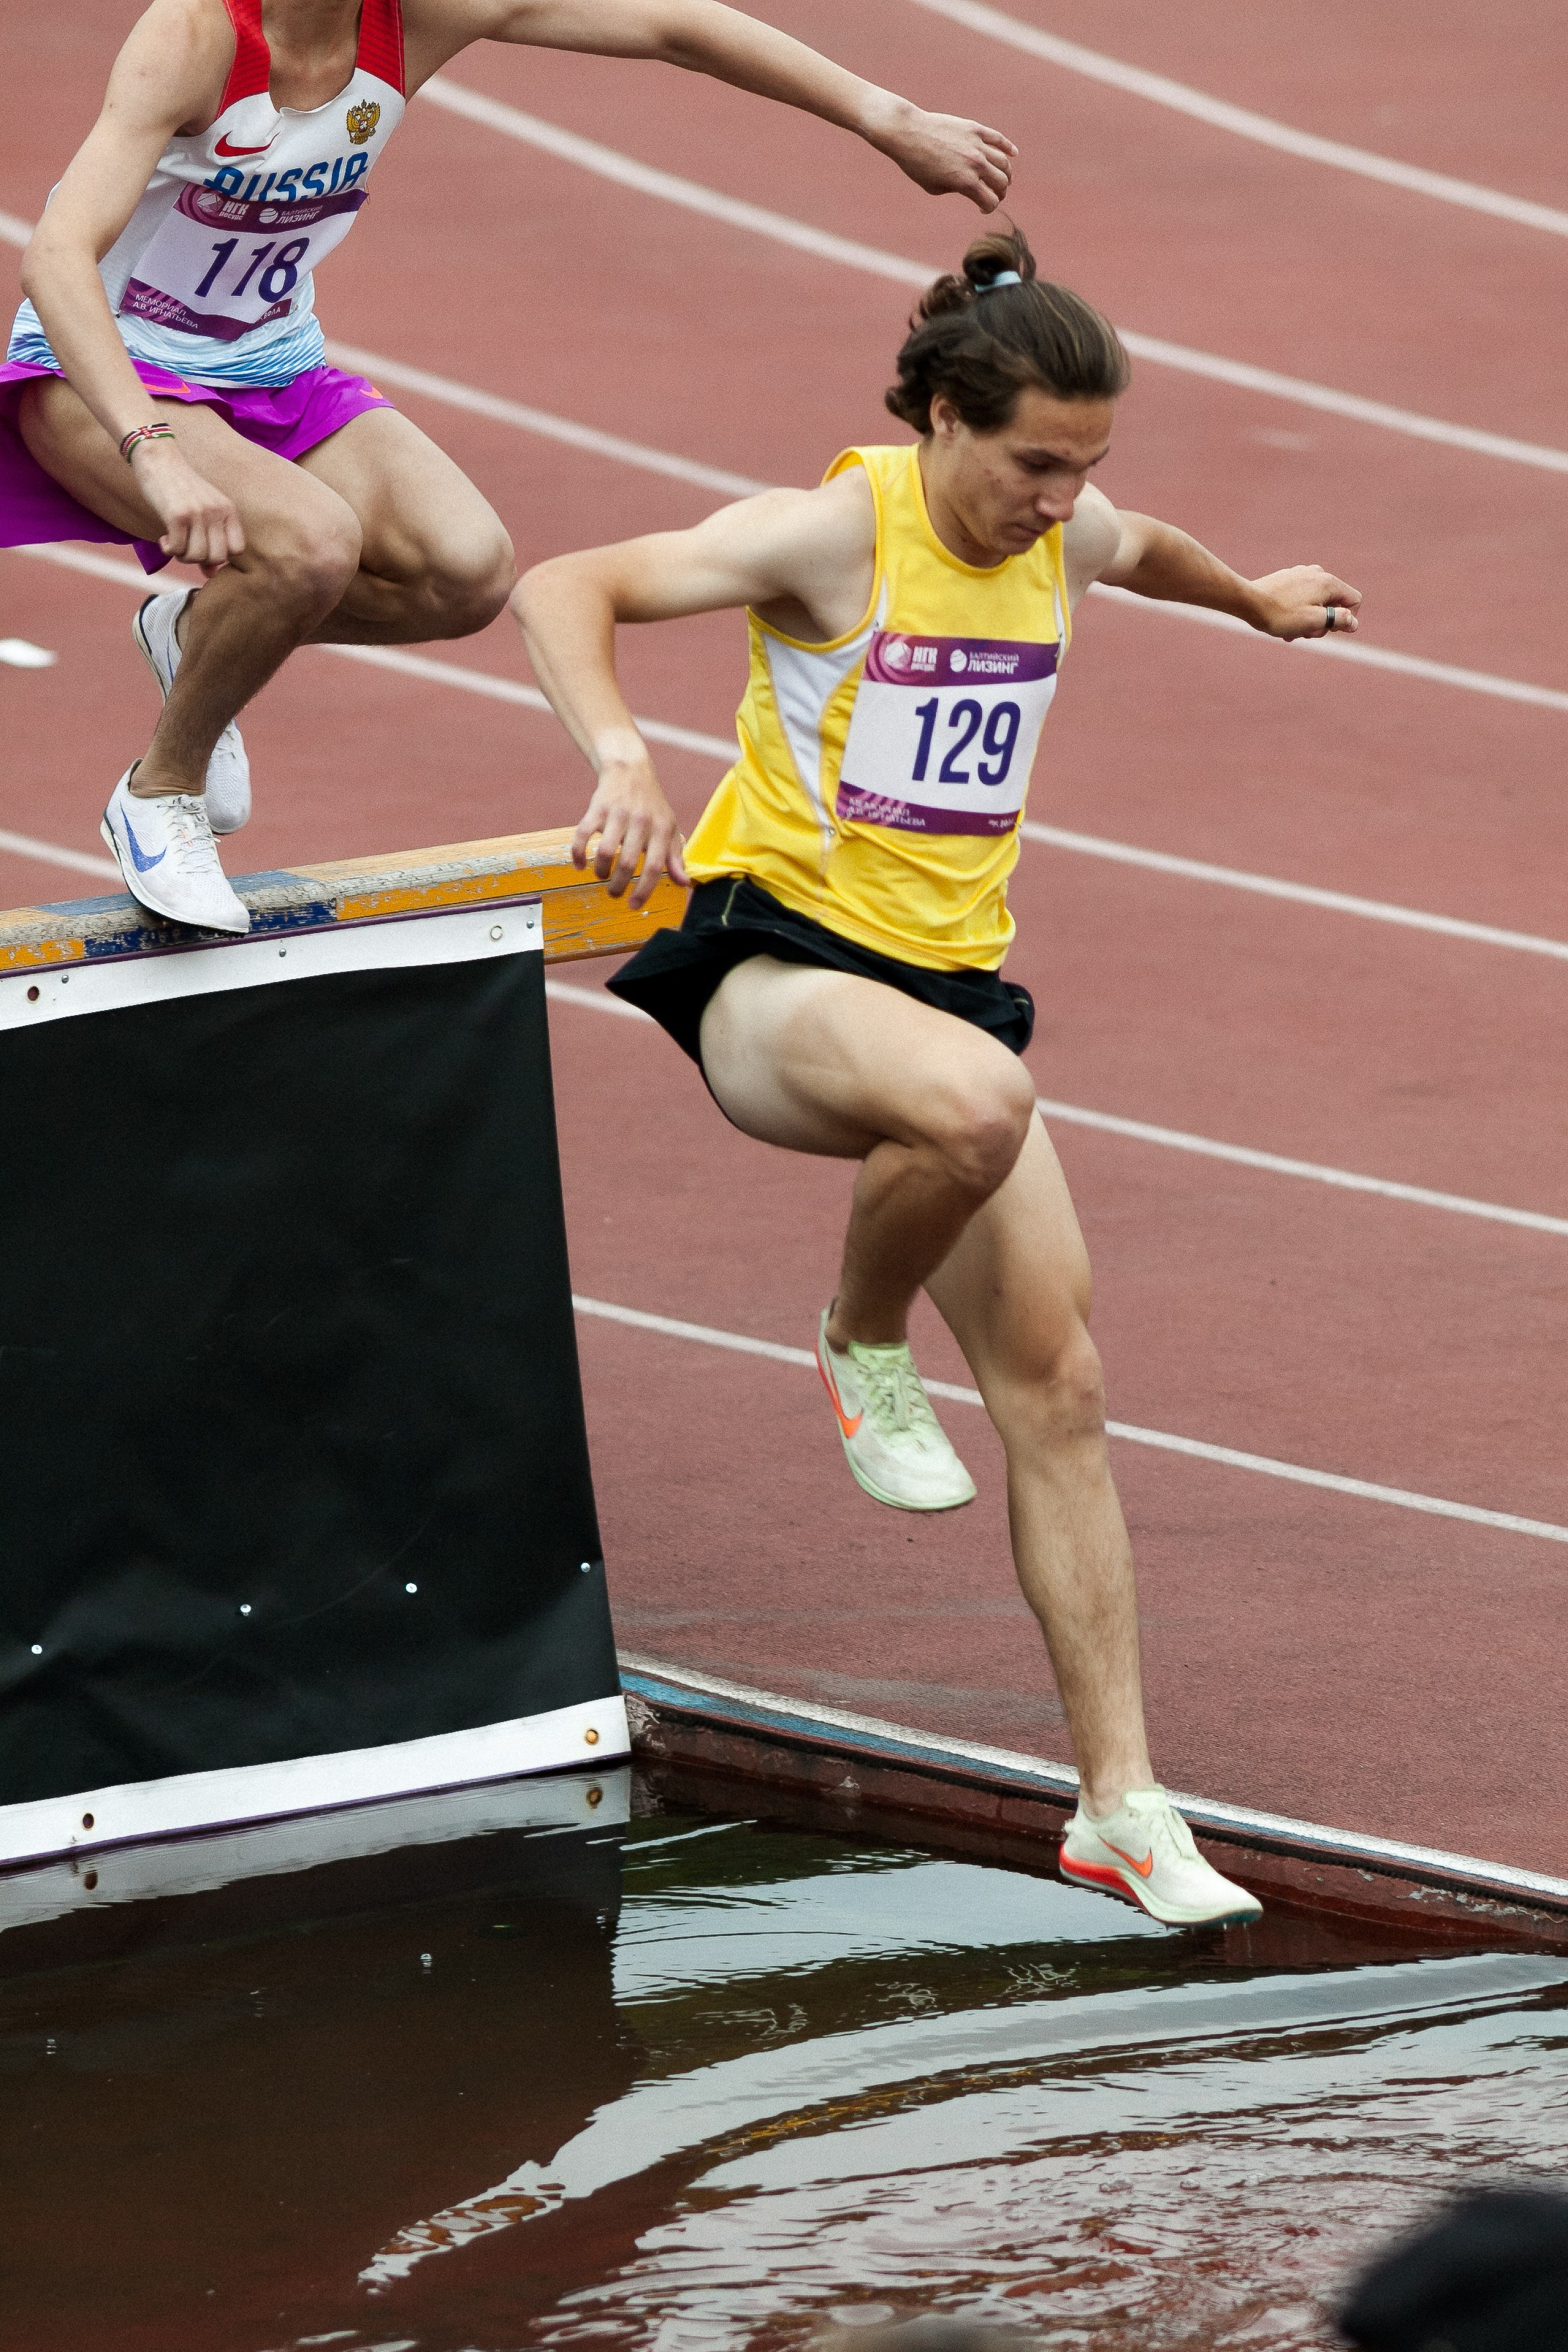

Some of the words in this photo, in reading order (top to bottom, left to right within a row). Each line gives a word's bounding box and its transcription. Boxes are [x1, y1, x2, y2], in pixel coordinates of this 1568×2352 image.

[203, 151, 369, 202] RUSSIA
[222, 200, 250, 215] НГК
[276, 210, 320, 224] ЛИЗИНГ
[194, 237, 310, 303] 118
[132, 301, 147, 311] А.В.
[150, 306, 198, 329] ИГНАТЬЕВА
[135, 294, 186, 316] МЕМОРИАЛ
[967, 660, 1019, 675] ЛИЗИНГ
[912, 698, 1020, 785] 129
